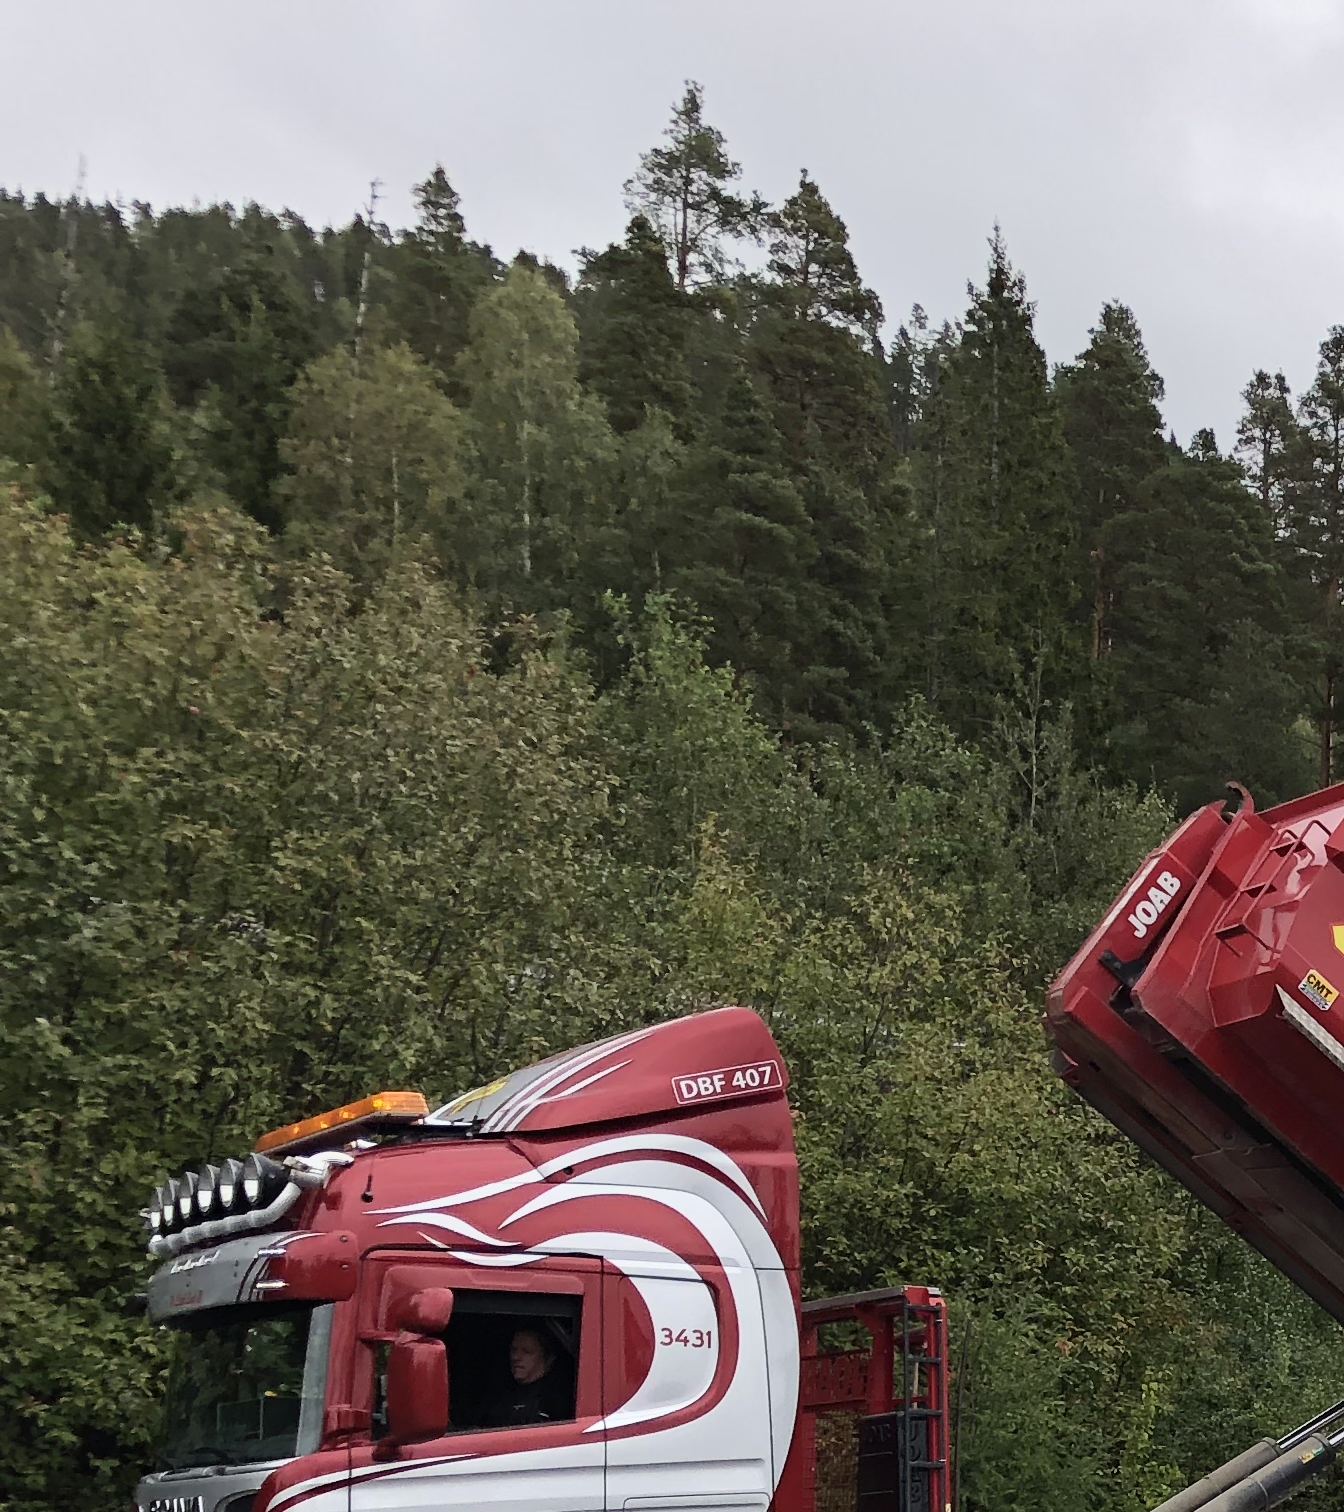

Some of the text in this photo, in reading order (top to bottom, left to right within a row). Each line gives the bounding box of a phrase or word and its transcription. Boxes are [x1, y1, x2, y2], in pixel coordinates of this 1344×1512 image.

[1127, 871, 1181, 938] JOAB
[1306, 973, 1333, 998] CMT
[680, 1066, 771, 1099] DBF 407
[660, 1327, 712, 1349] 3431
